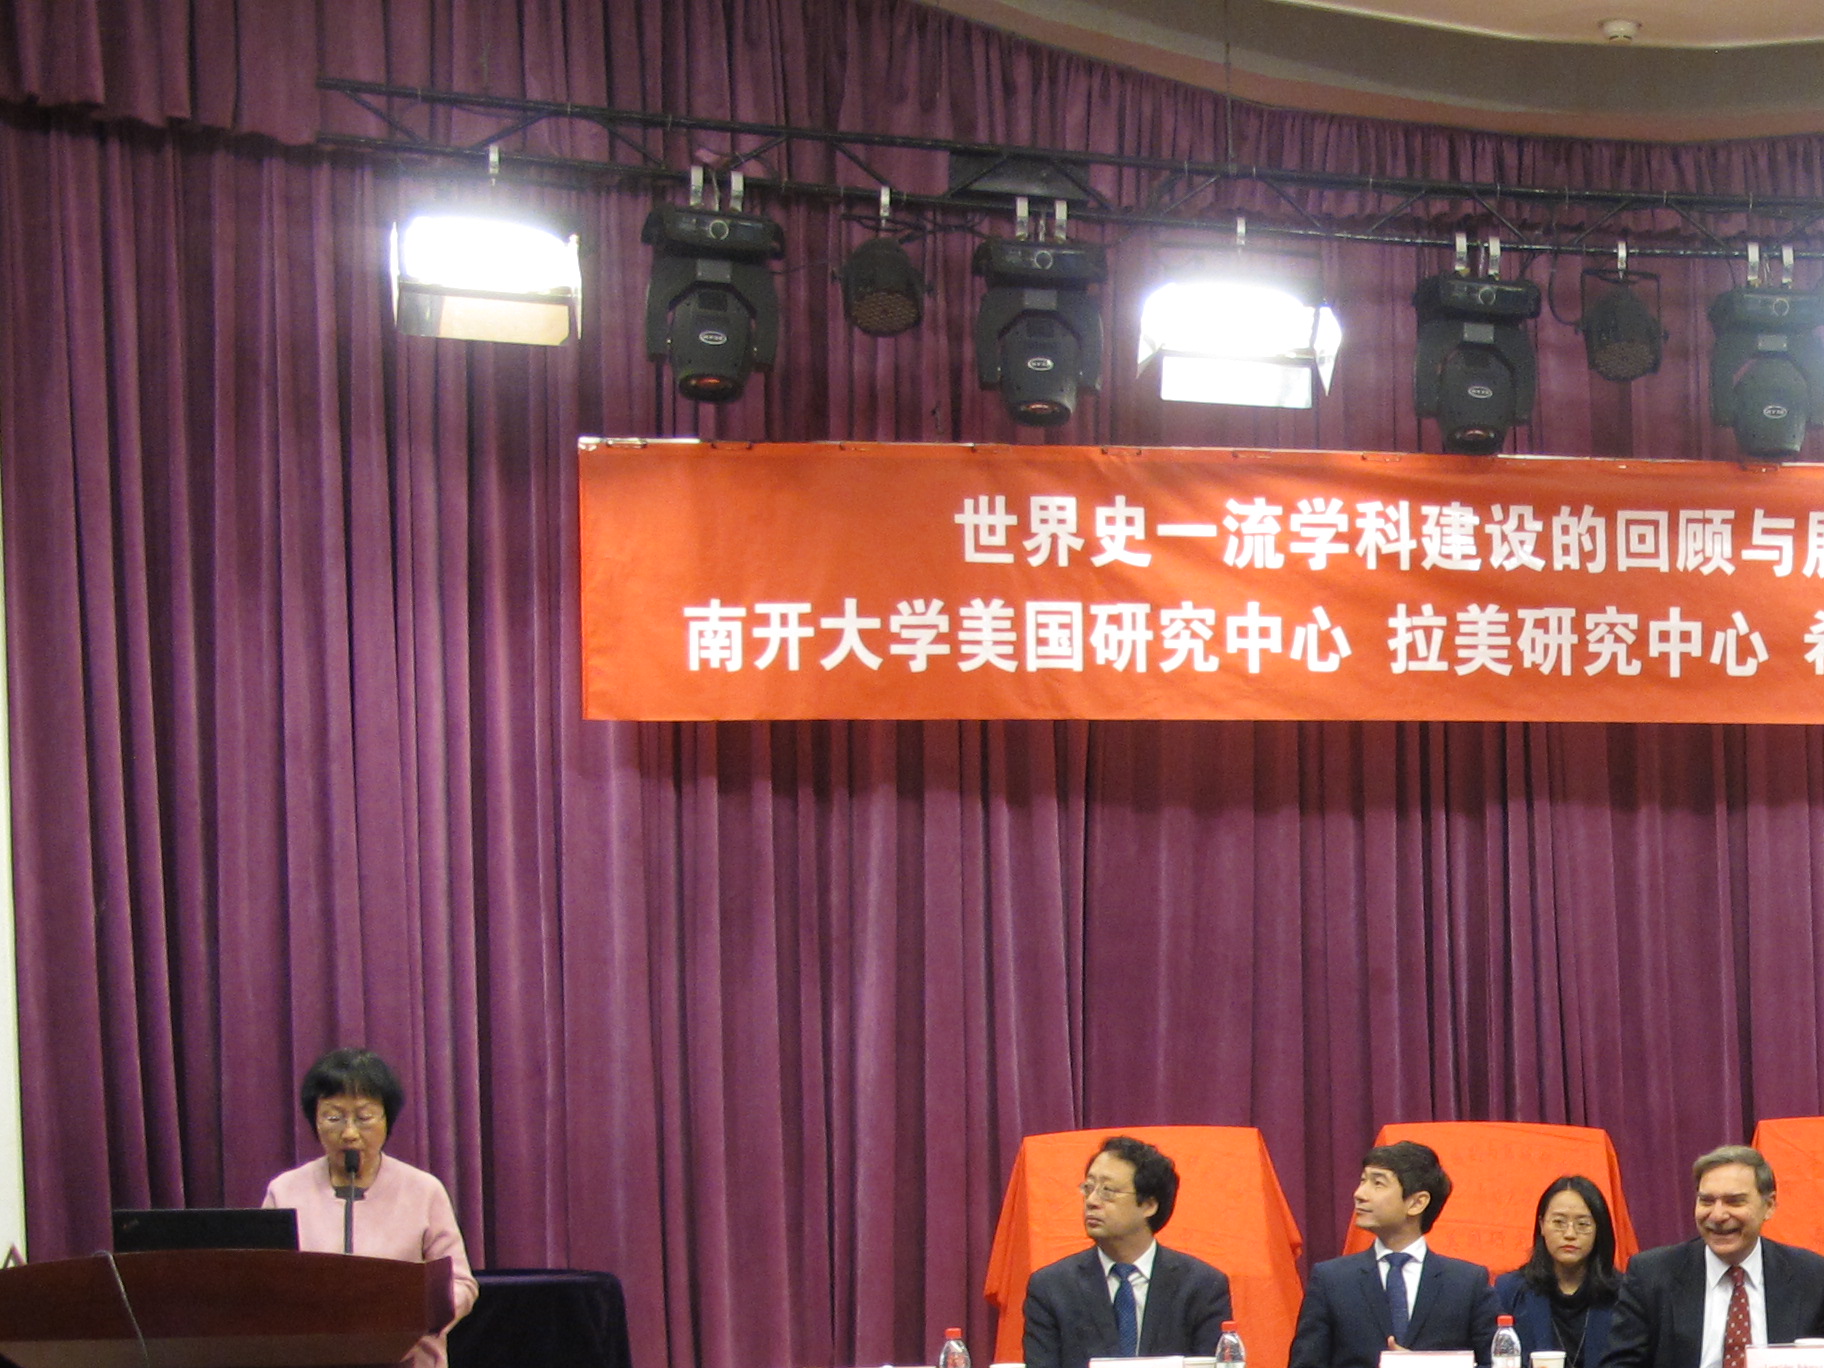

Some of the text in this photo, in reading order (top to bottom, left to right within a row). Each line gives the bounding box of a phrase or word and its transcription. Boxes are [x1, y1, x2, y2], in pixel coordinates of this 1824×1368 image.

[682, 597, 1354, 675] 南开大学美国研究中心
[1386, 602, 1770, 679] 拉美研究中心
